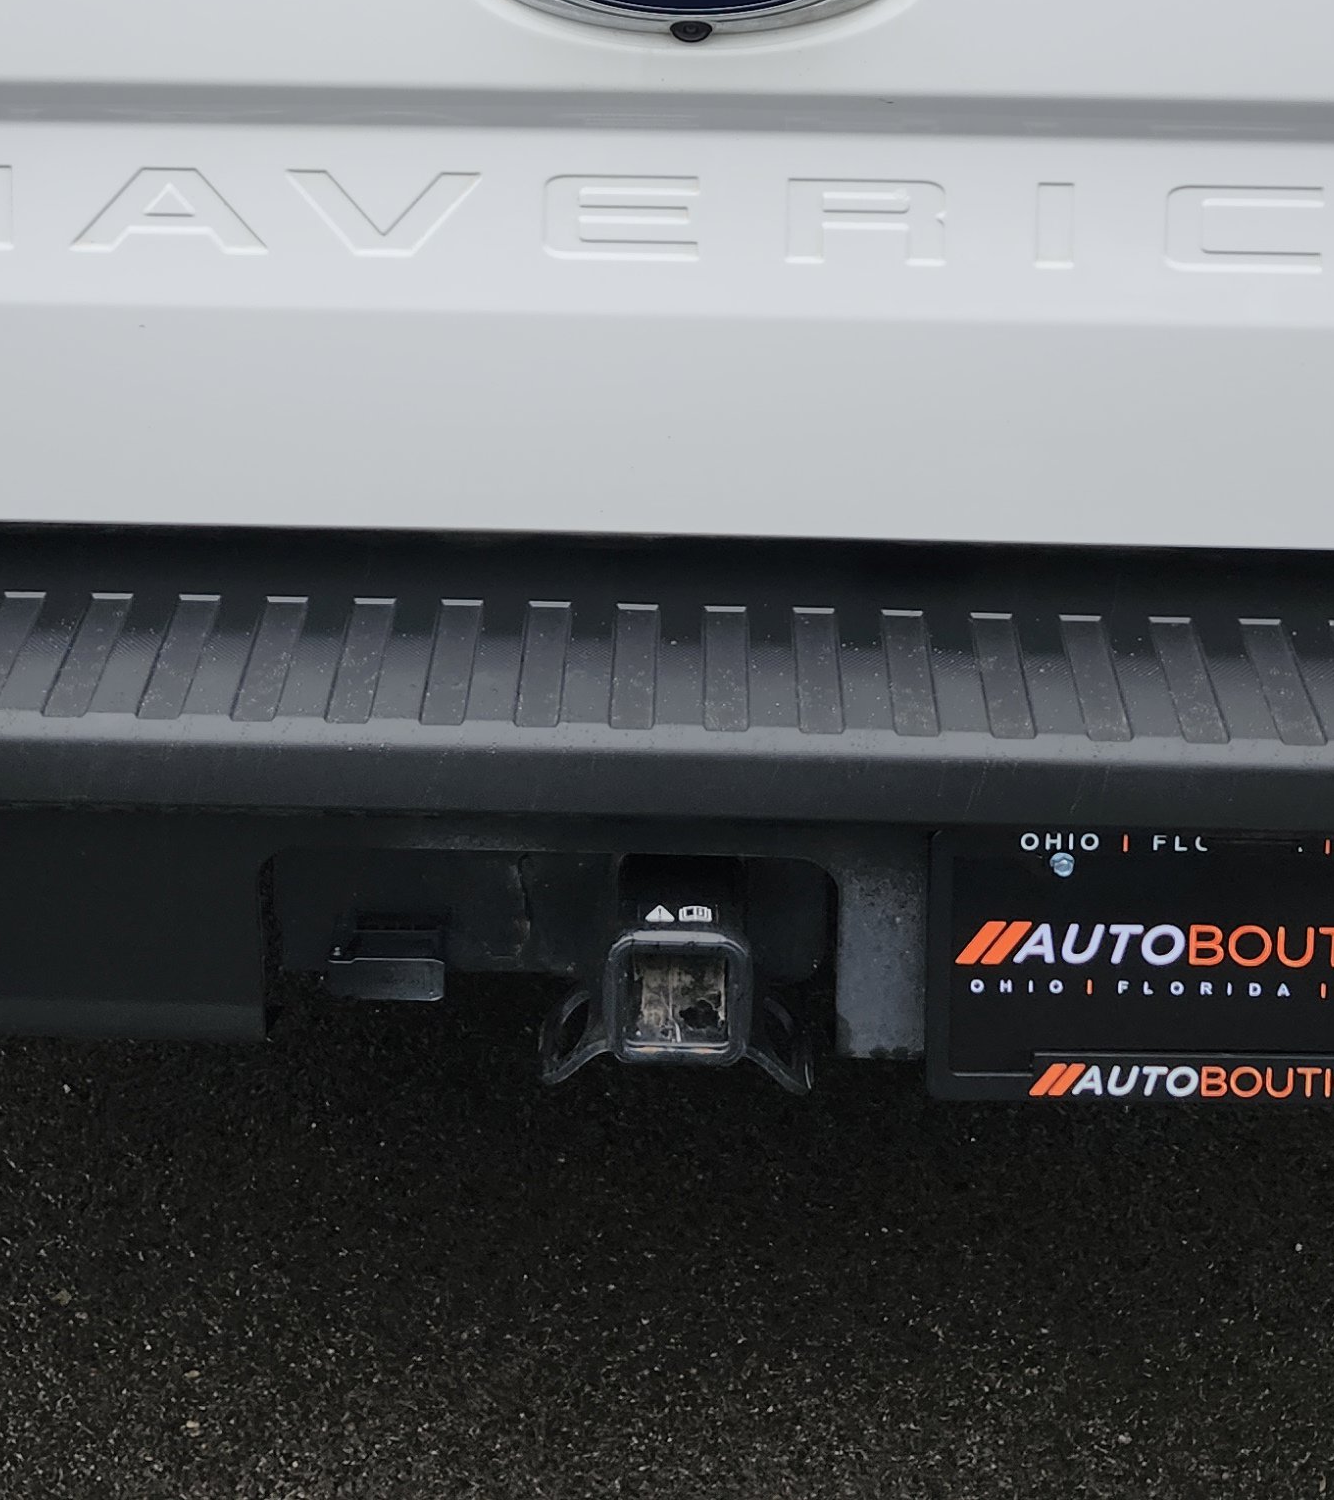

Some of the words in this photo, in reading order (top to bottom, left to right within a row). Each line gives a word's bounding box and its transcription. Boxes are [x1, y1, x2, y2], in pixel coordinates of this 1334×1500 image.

[1019, 832, 1100, 851] OHIO
[969, 978, 1065, 995] OHIO
[1117, 980, 1292, 998] FLORIDA
